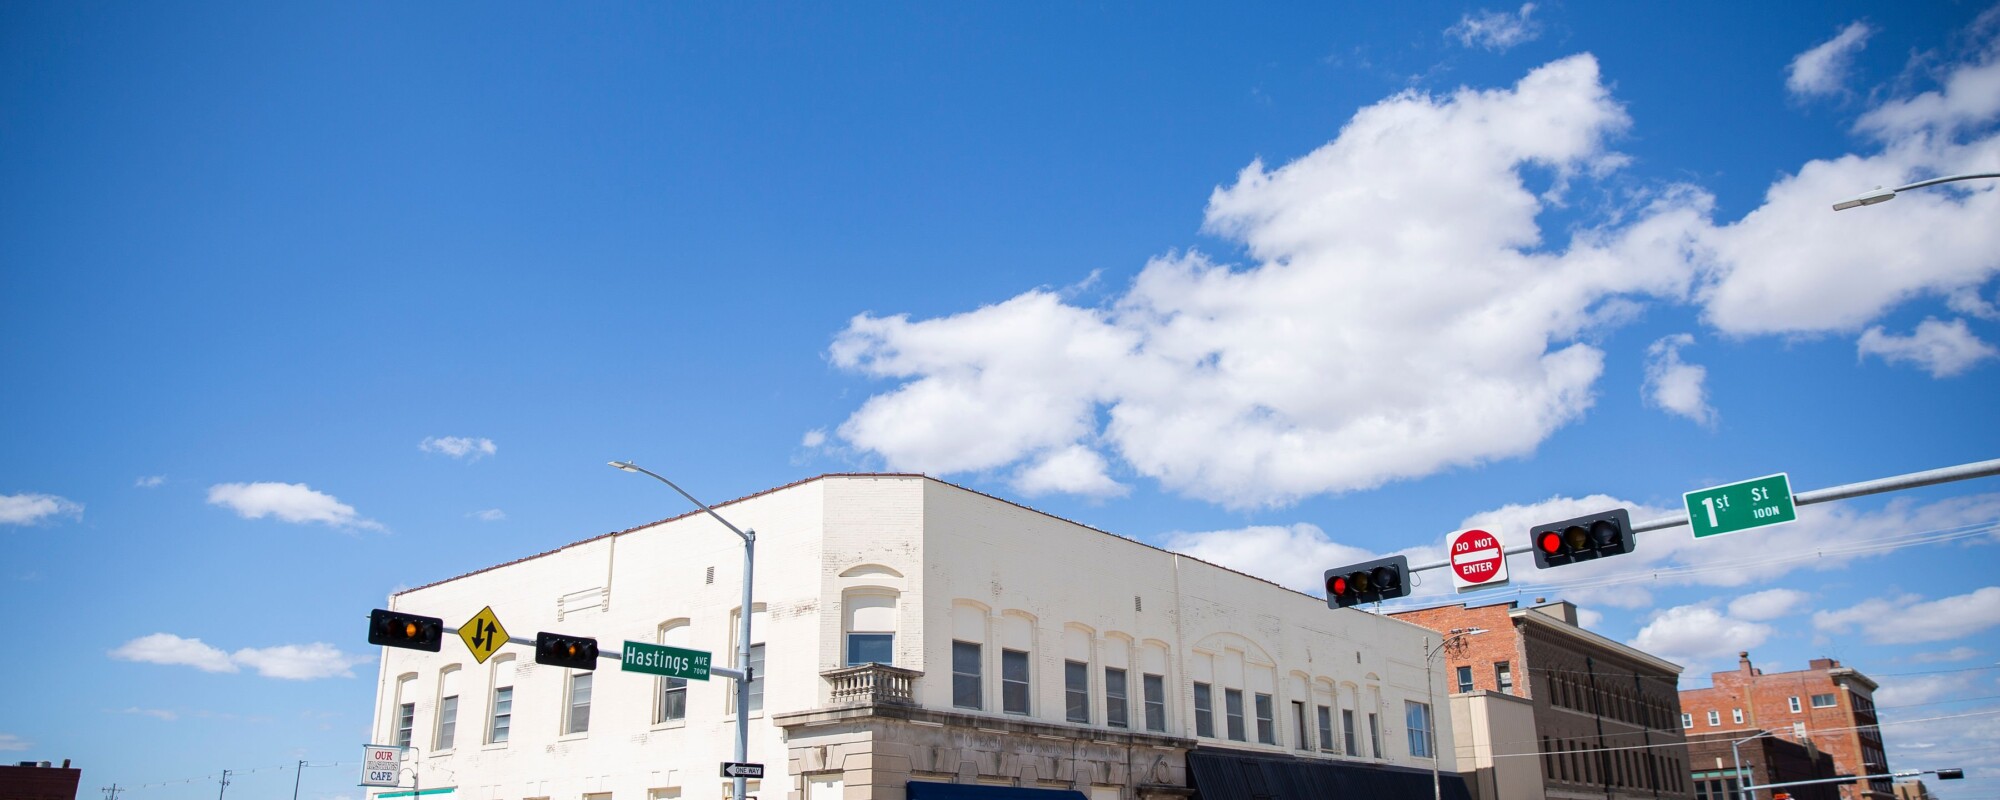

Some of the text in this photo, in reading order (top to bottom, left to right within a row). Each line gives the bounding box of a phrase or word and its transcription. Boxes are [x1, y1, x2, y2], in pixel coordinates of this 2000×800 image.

[1701, 486, 1769, 528] 1st St
[1753, 506, 1780, 519] 100N
[1456, 537, 1492, 552] DO NOT
[1463, 562, 1493, 575] ENTER
[626, 646, 708, 675] Hastings AVE
[375, 751, 393, 760] OUR
[371, 771, 393, 781] CAFE
